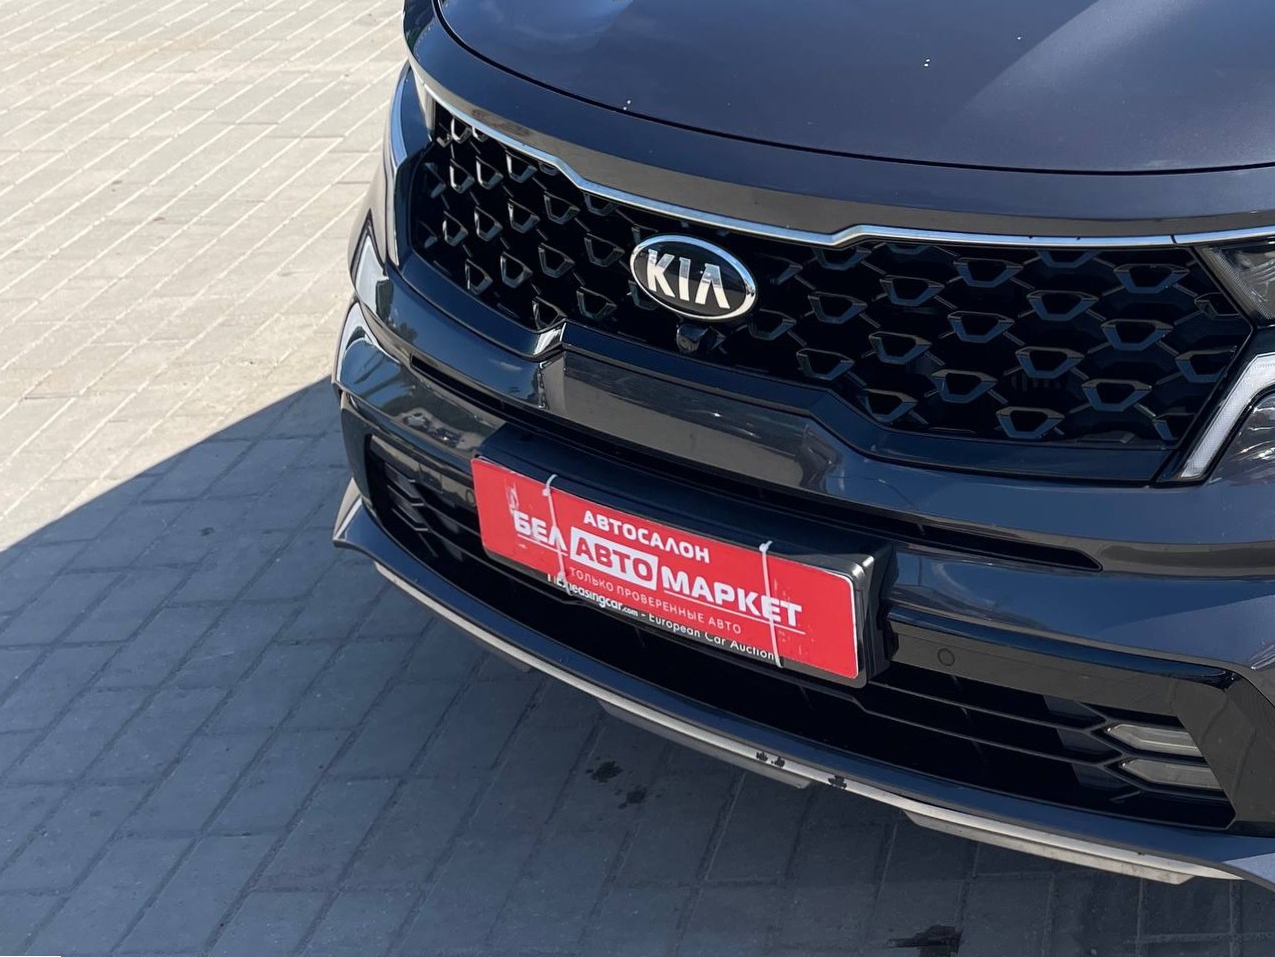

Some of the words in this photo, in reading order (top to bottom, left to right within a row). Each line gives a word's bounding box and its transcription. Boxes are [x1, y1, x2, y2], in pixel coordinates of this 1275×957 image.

[646, 248, 731, 310] KIA
[583, 509, 711, 564] АВТОСАЛОН
[513, 509, 568, 552] БЕЛ
[575, 536, 654, 582] АВТО
[661, 565, 803, 627] МАРКЕТ
[569, 566, 614, 592] ТОЛЬКО
[616, 585, 705, 623] ПРОВЕРЕННЫЕ
[708, 616, 742, 635] АВТО
[649, 613, 701, 639] European
